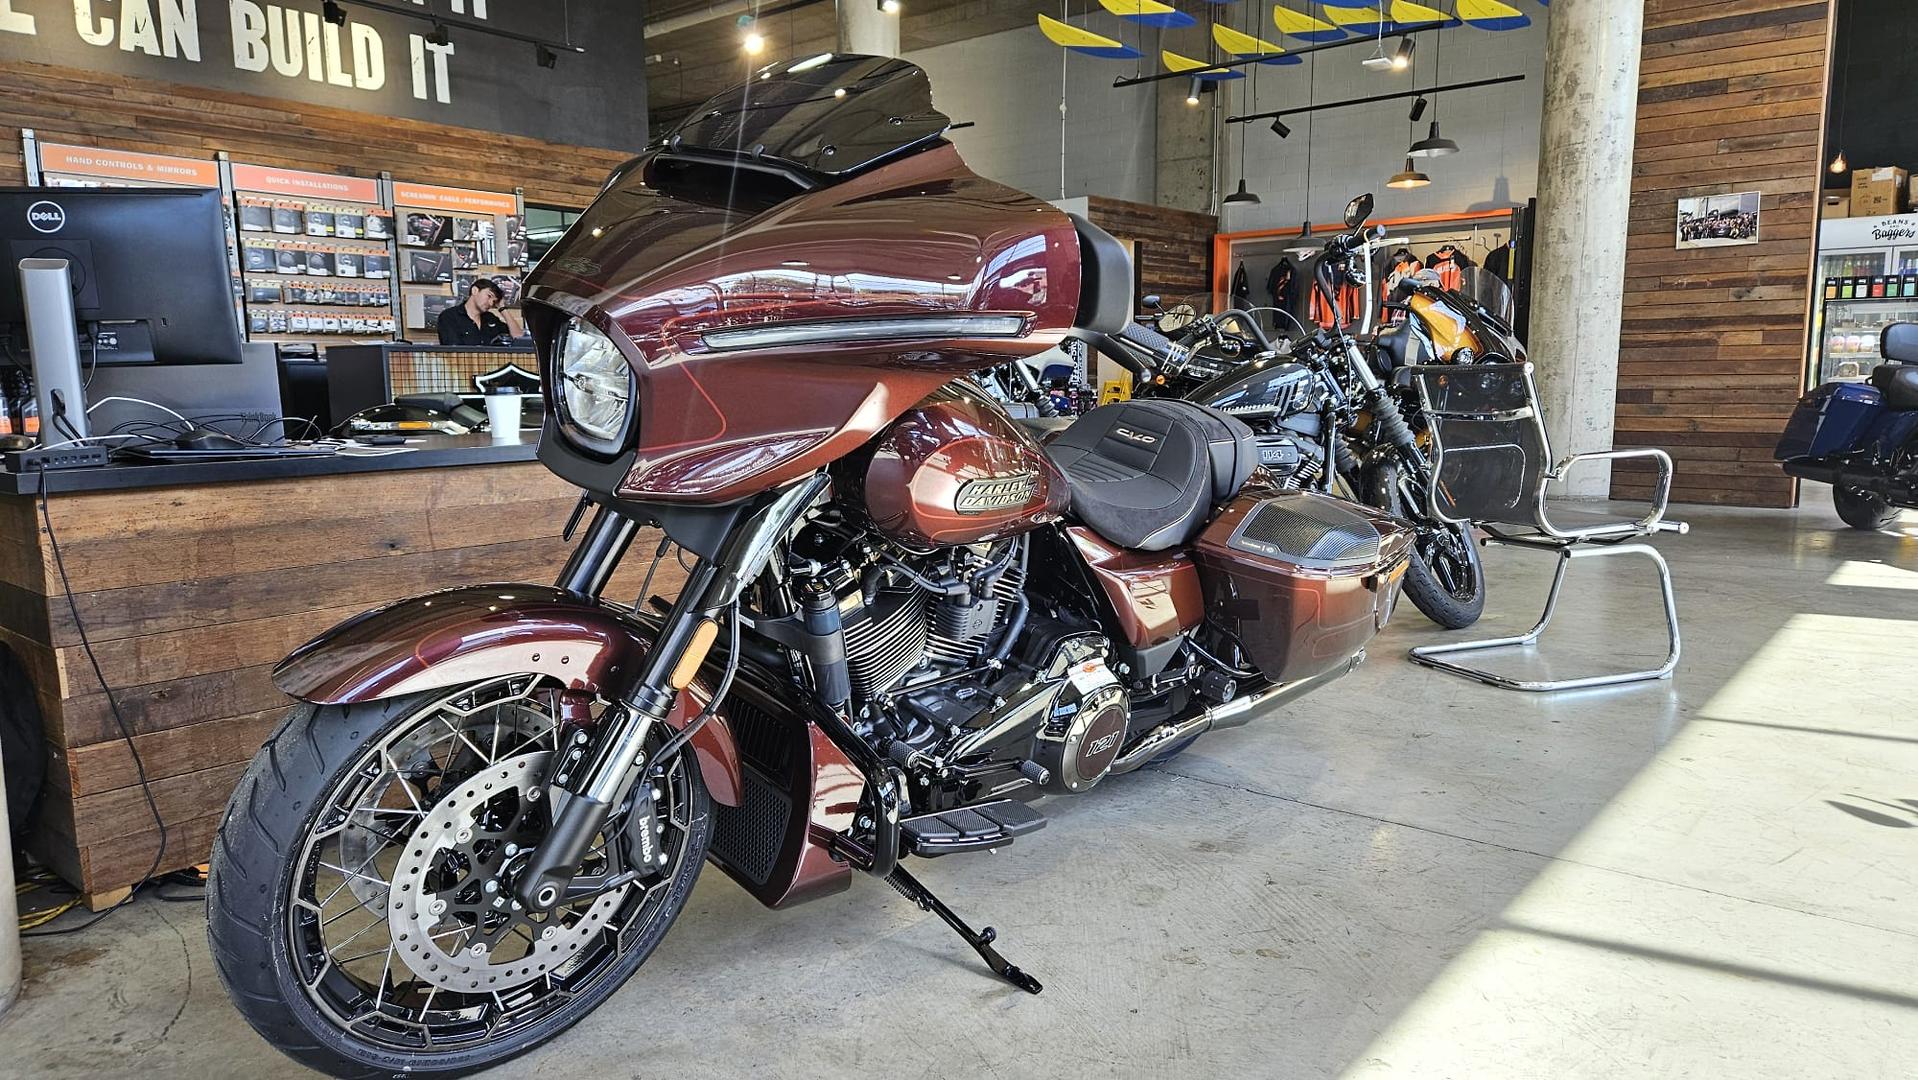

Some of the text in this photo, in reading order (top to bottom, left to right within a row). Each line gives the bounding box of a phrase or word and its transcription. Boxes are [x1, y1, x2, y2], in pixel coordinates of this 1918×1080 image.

[73, 0, 201, 62] CAN
[230, 0, 386, 91] BUILD
[409, 33, 455, 104] IT
[65, 155, 93, 165] HAND
[95, 158, 144, 170] CONTROLS
[156, 165, 198, 176] MIRRORS
[265, 175, 349, 192] QUICK INSTALLATIONS
[31, 211, 62, 221] DELL
[1871, 228, 1916, 240] Baggers
[1262, 449, 1284, 461] 114
[968, 480, 1026, 496] HARLEY
[960, 490, 1032, 507] DAVIDSON
[1085, 731, 1120, 758] 121
[638, 815, 654, 864] brembo
